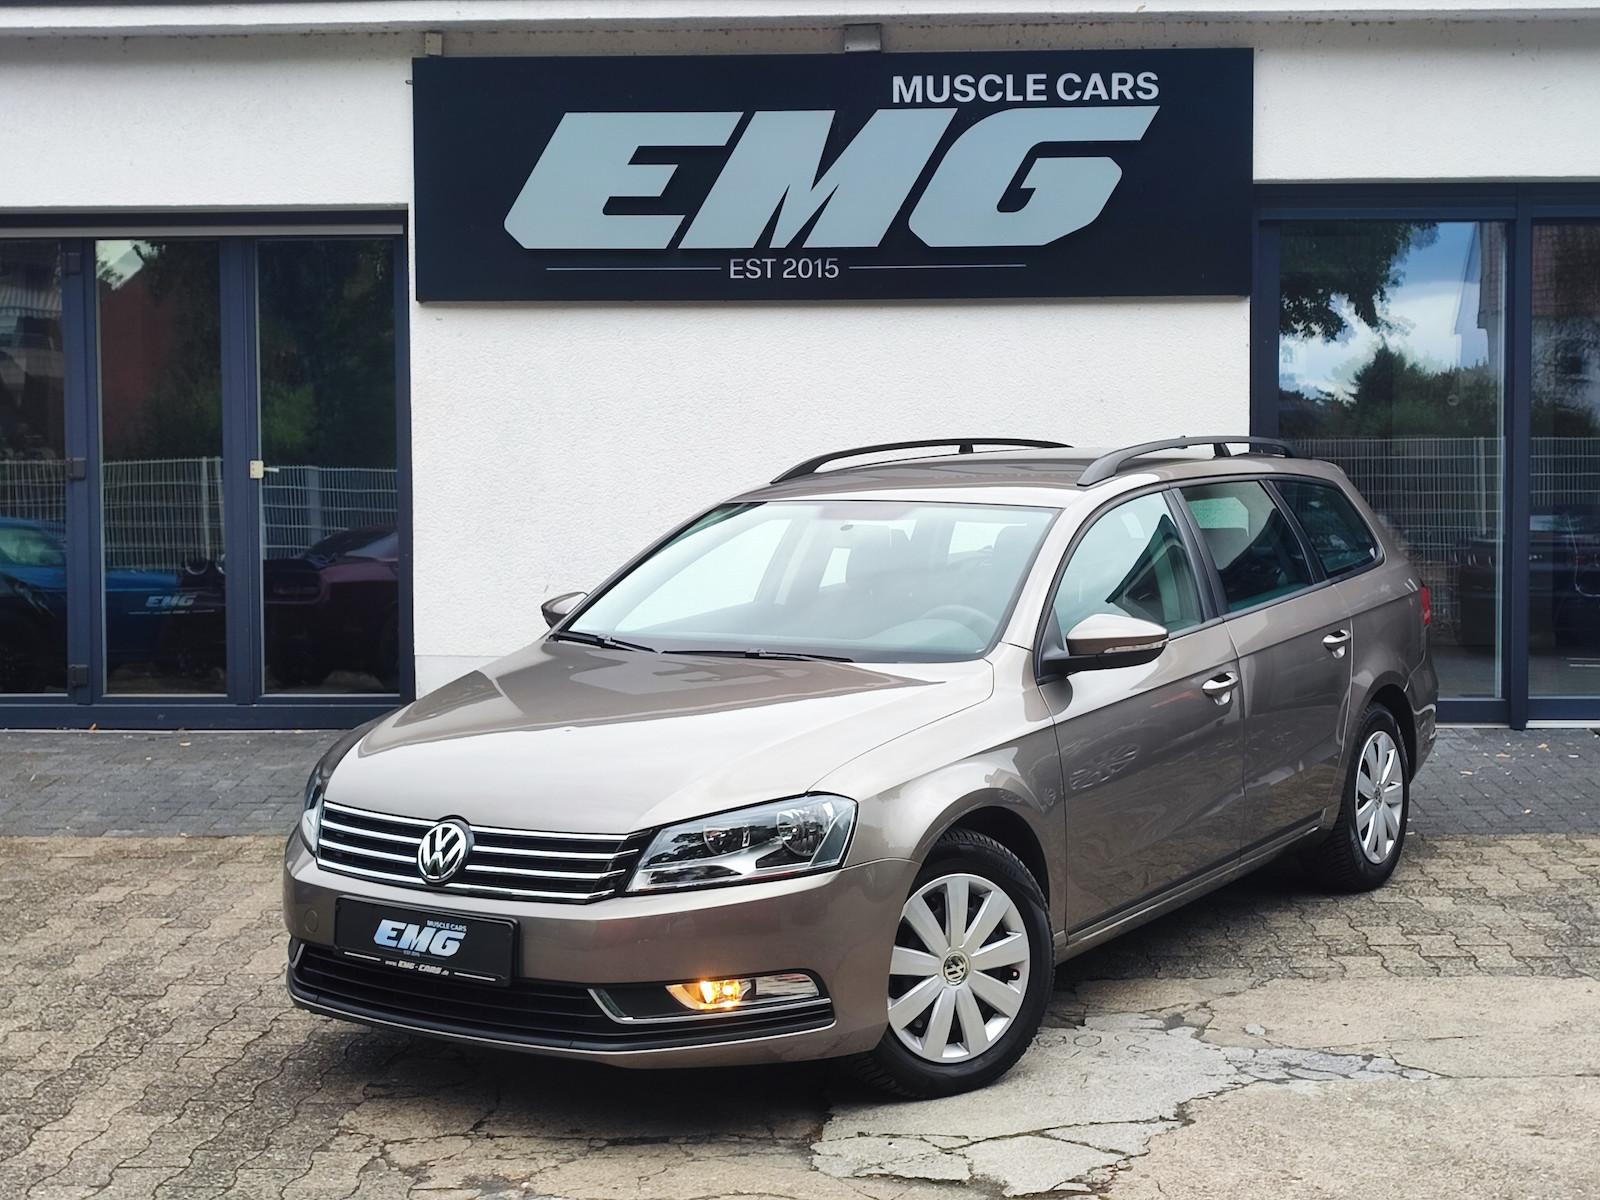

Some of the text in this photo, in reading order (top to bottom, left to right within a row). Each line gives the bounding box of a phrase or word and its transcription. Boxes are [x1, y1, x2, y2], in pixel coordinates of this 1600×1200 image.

[892, 71, 1160, 104] MUSCLE CARS
[503, 105, 1161, 250] EMG
[729, 258, 839, 279] EST 2015
[373, 919, 466, 957] EMG
